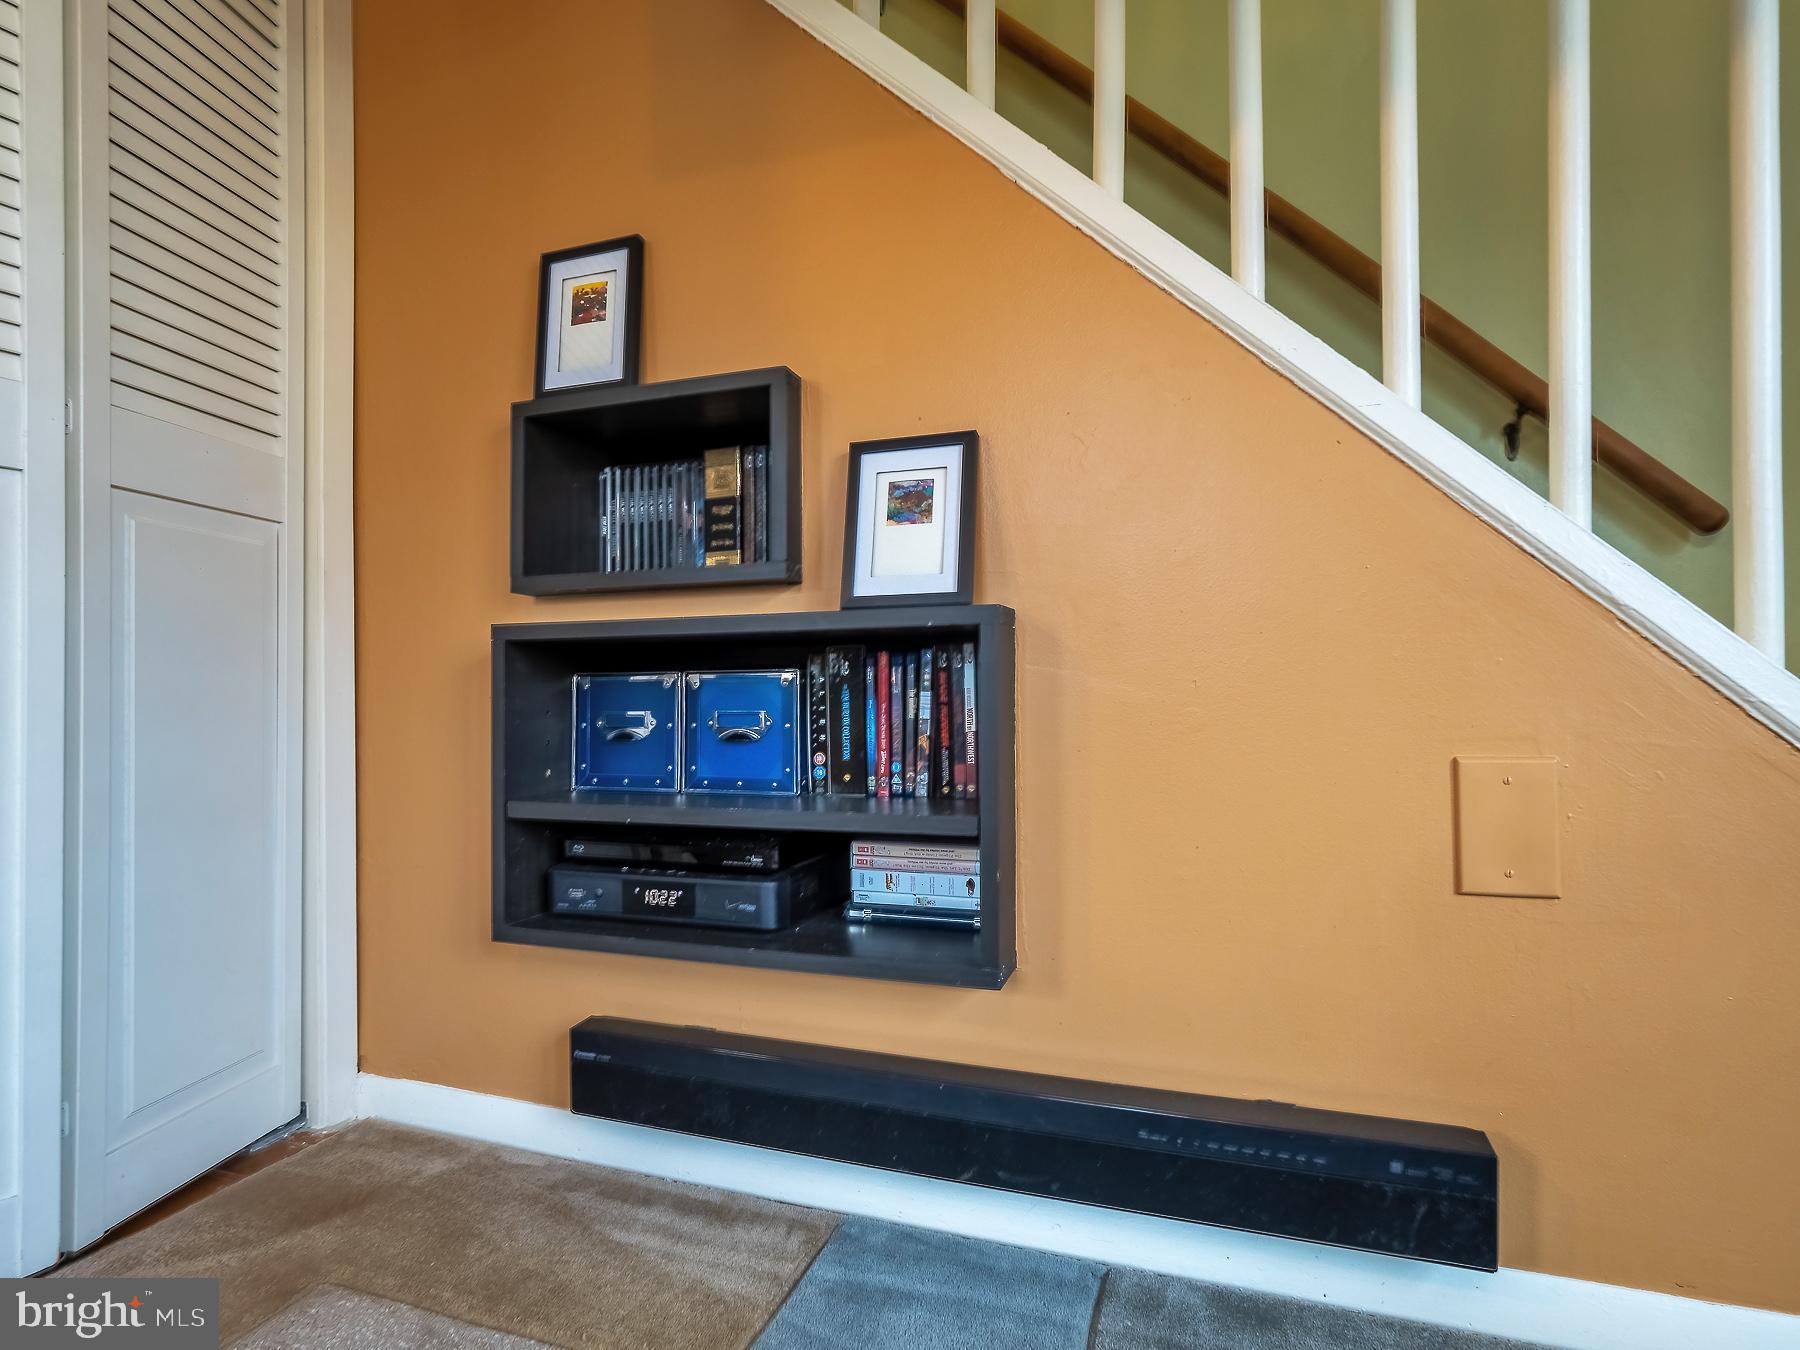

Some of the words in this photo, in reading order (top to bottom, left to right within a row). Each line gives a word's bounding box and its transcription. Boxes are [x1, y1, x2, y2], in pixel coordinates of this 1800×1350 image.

[842, 702, 850, 725] BURTON
[842, 726, 850, 760] COLLECTION
[966, 732, 974, 764] NORTHWEST
[644, 889, 678, 906] 1022
